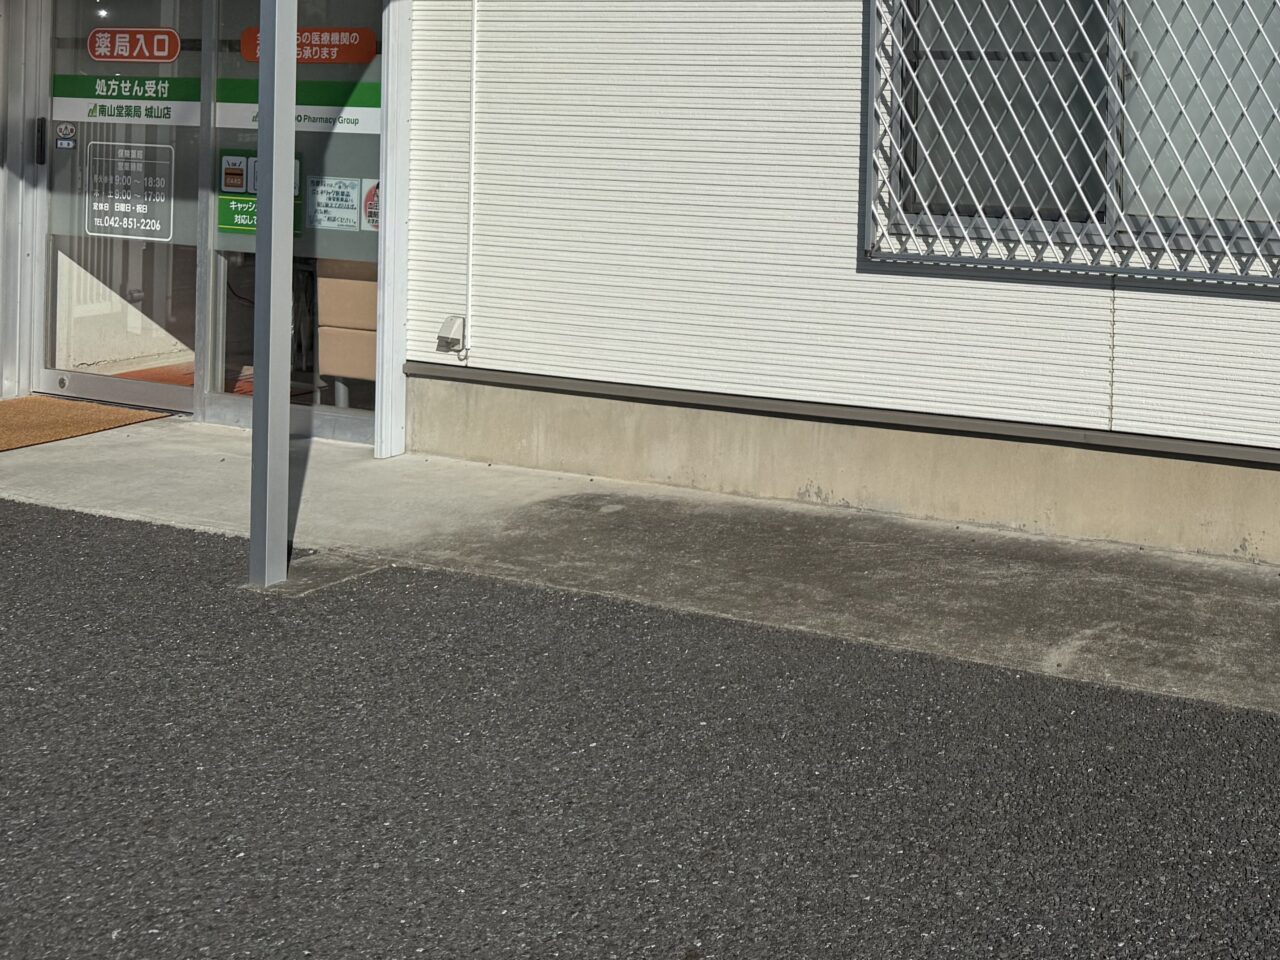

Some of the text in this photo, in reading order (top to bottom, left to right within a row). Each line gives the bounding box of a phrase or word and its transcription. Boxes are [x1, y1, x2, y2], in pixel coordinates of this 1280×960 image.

[95, 32, 169, 57] 薬局入口
[95, 79, 169, 98] 処方せん受付
[99, 104, 172, 119] 南山堂薬局 城山店
[303, 114, 336, 127] Pharmacy
[338, 115, 360, 127] Group
[229, 201, 257, 212] キャッシ
